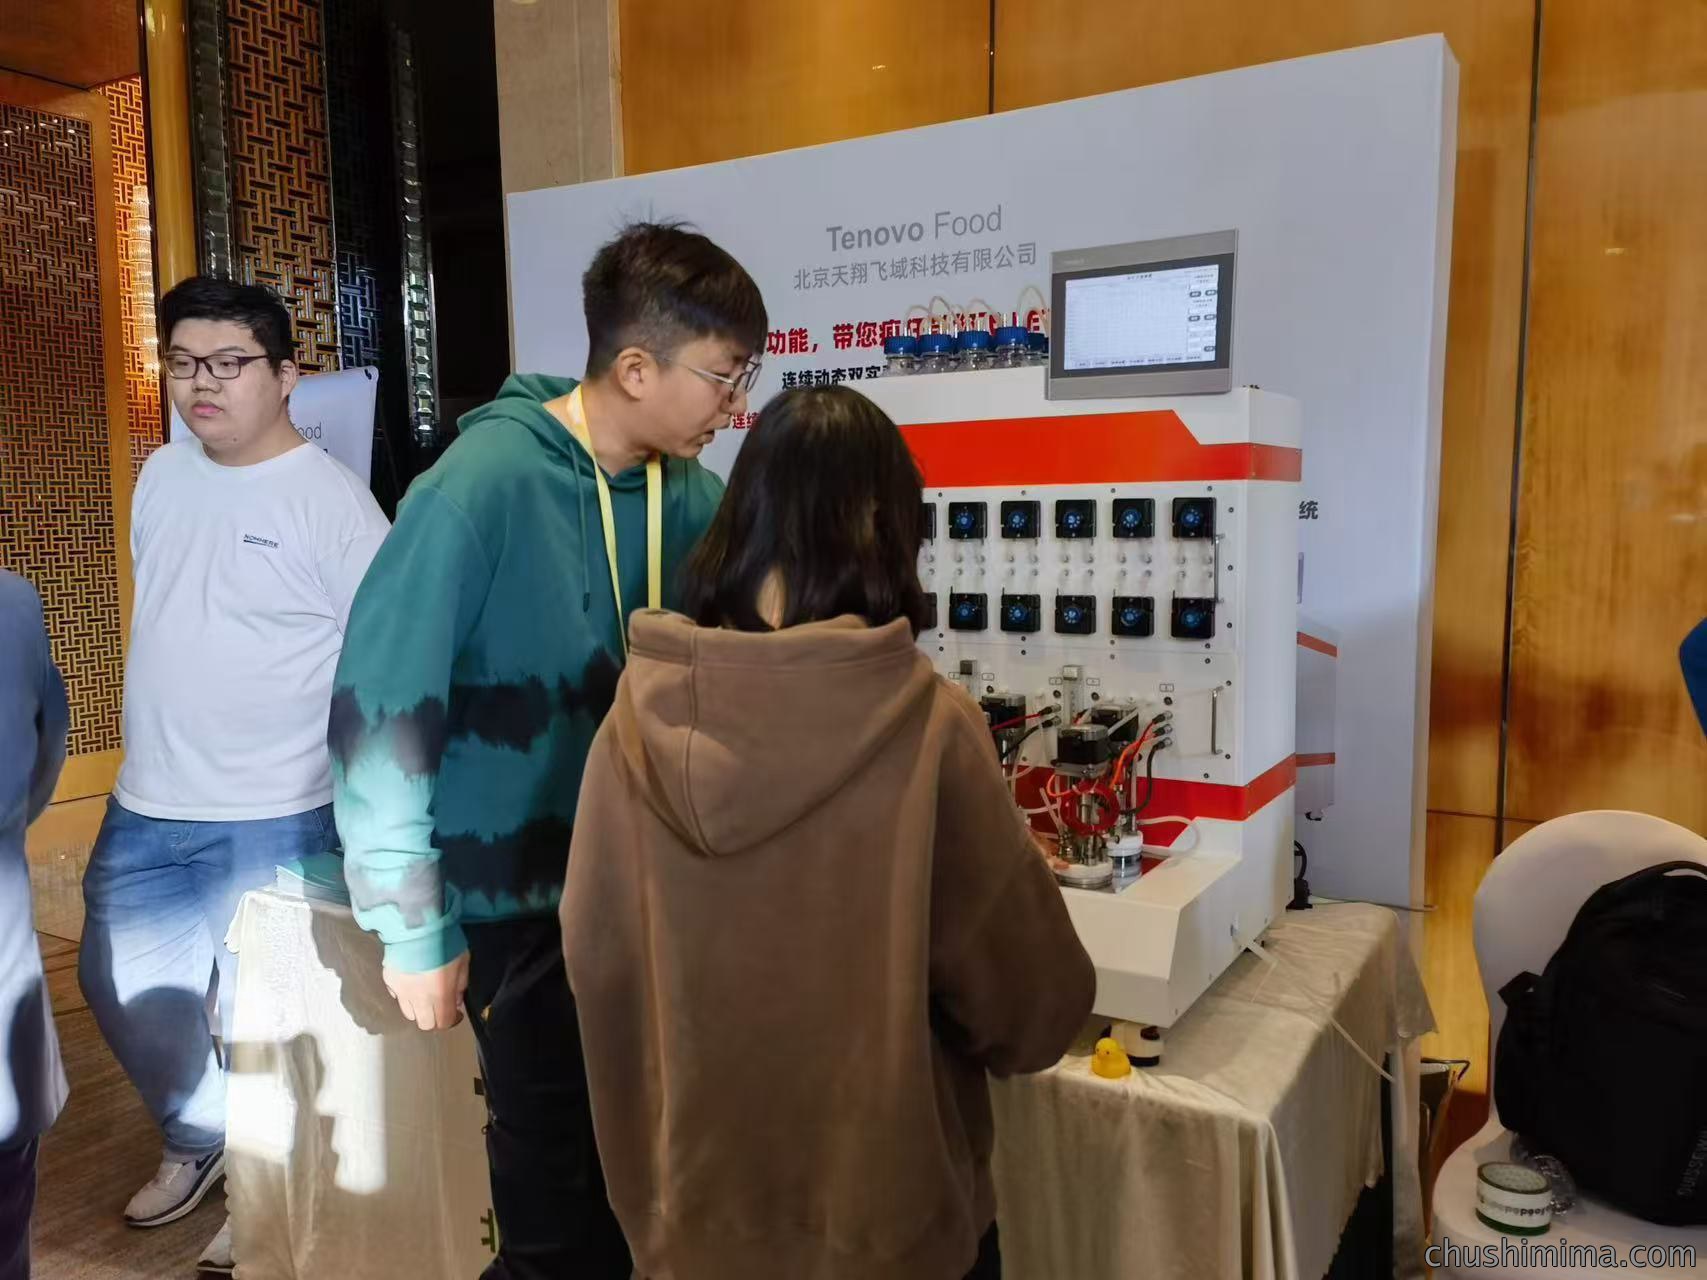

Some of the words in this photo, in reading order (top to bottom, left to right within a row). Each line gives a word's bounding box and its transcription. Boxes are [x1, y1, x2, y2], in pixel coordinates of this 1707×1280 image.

[826, 221, 924, 251] Tenovo
[934, 204, 1002, 240] Food
[793, 242, 1037, 290] 北京天翔飞域科技有限公司
[1299, 500, 1319, 520] 统
